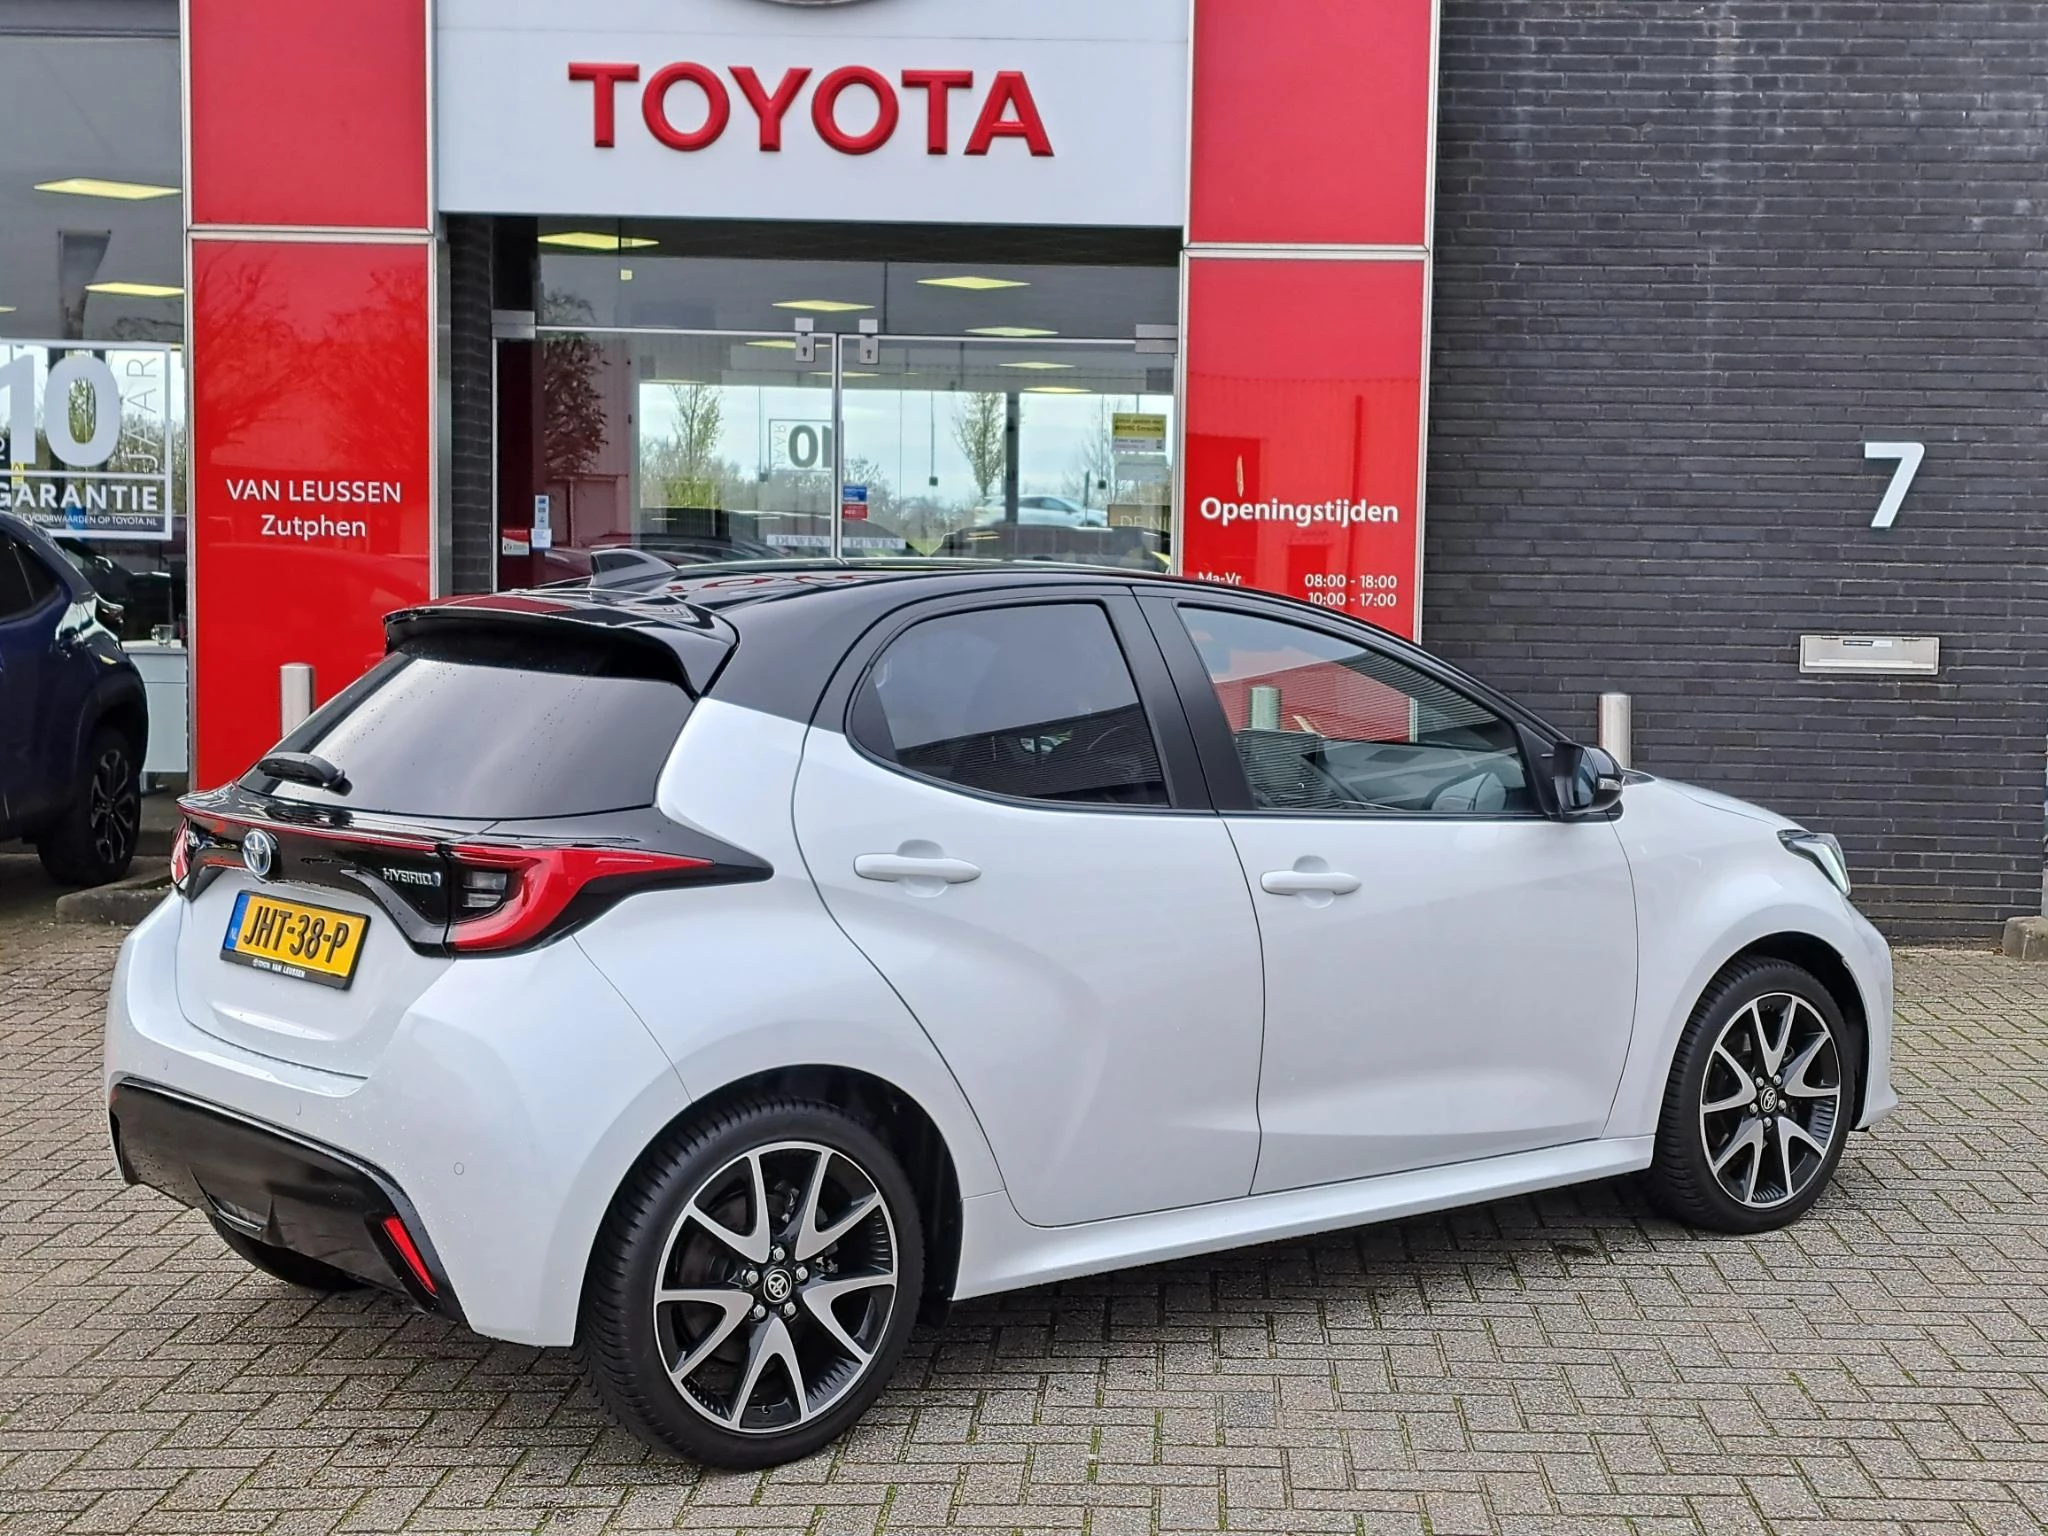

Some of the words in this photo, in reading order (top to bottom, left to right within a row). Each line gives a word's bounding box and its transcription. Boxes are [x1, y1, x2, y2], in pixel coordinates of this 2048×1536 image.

[568, 61, 1055, 158] TOYOTA
[0, 354, 121, 468] 10
[126, 357, 158, 474] JAAR
[0, 482, 158, 512] GARANTIE
[226, 478, 280, 502] VAN
[288, 480, 401, 503] LEUSSEN
[1864, 441, 1925, 528] 7
[98, 516, 110, 525] OP
[1200, 497, 1399, 528] Openingstijden
[260, 515, 367, 541] Zutphen
[775, 535, 824, 546] DUWEN
[1197, 571, 1242, 586] Ma-Vr
[1304, 573, 1347, 588] 08:00
[1359, 575, 1397, 589] 18:00
[1308, 591, 1347, 606] 10:00
[1359, 593, 1397, 607] 17:00
[382, 867, 433, 886] HYBRID
[243, 905, 350, 964] JHT-38-P
